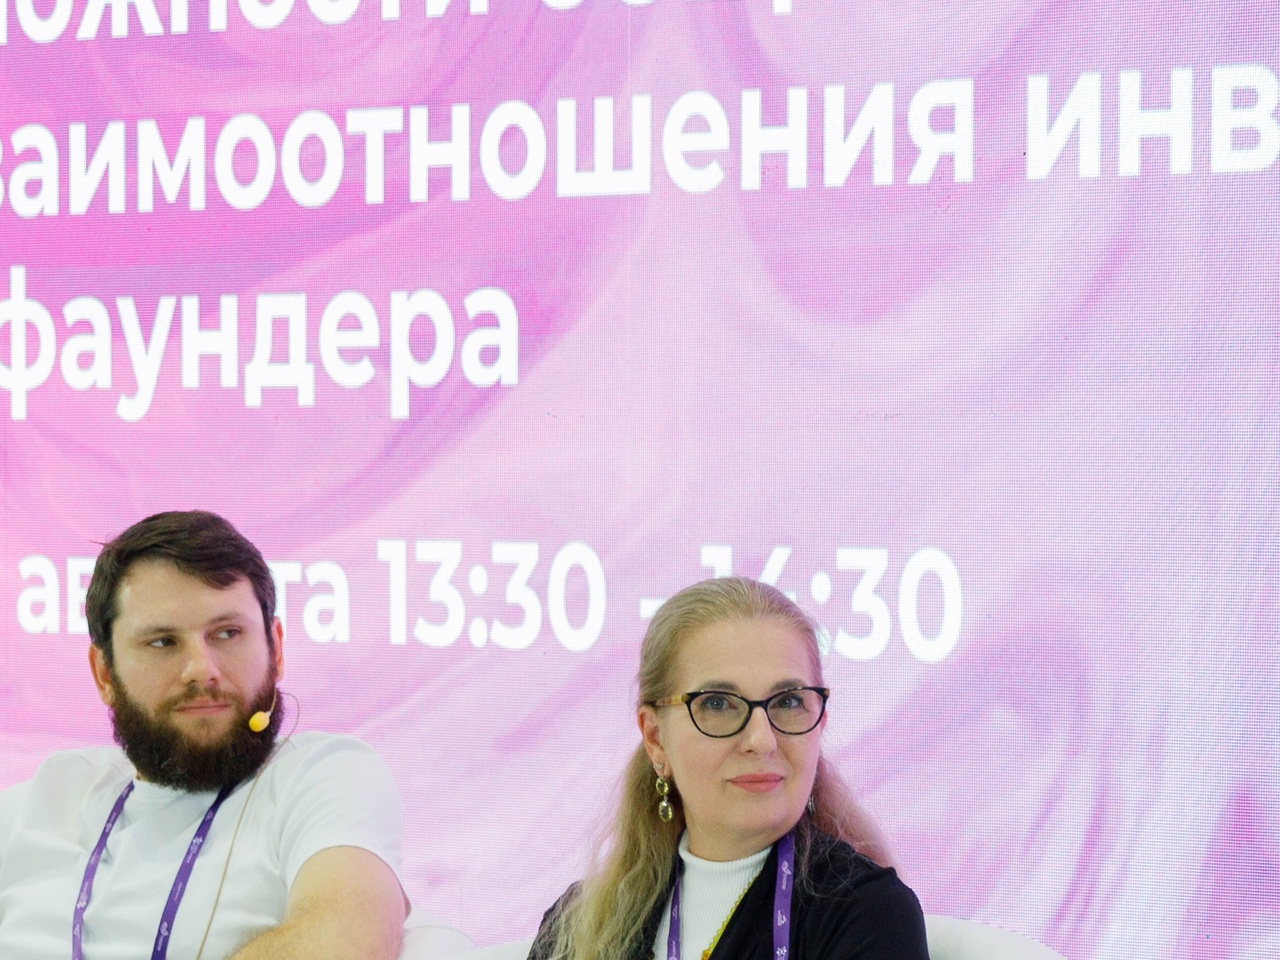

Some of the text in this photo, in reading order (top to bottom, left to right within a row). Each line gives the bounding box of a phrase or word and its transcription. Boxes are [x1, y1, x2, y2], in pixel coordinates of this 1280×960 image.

[1026, 63, 1280, 181] инв
[16, 554, 350, 643] авта
[377, 538, 607, 652] 13:30
